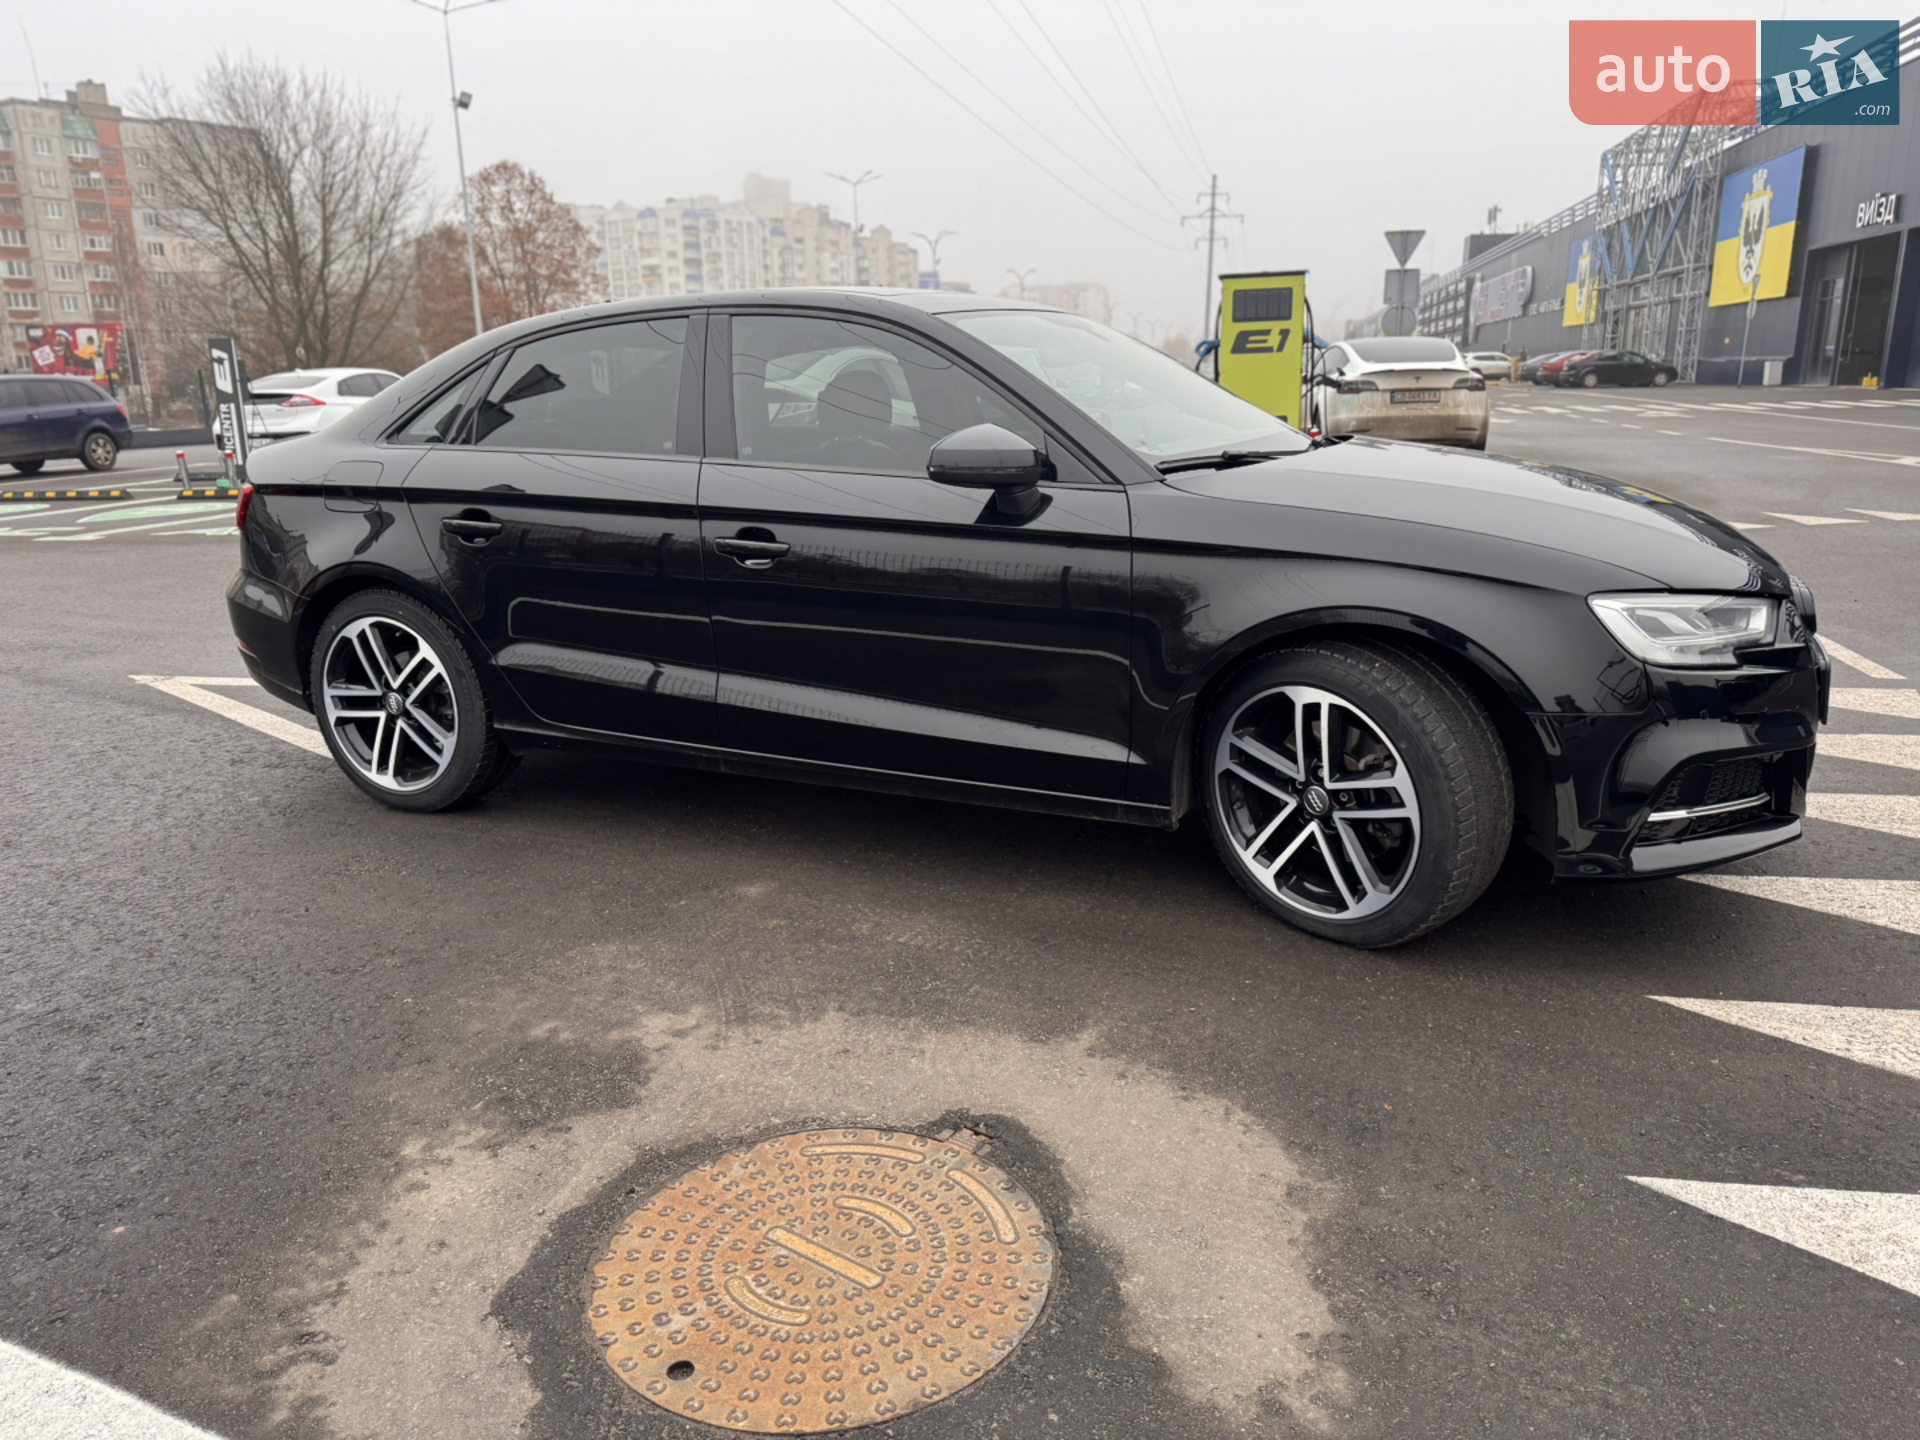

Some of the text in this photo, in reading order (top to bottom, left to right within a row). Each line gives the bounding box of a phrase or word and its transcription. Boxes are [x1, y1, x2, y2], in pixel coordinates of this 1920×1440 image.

[1856, 191, 1897, 229] ВИЇЗД
[1230, 328, 1291, 355] E1
[211, 348, 233, 394] E1
[219, 403, 236, 451] ICENTR
